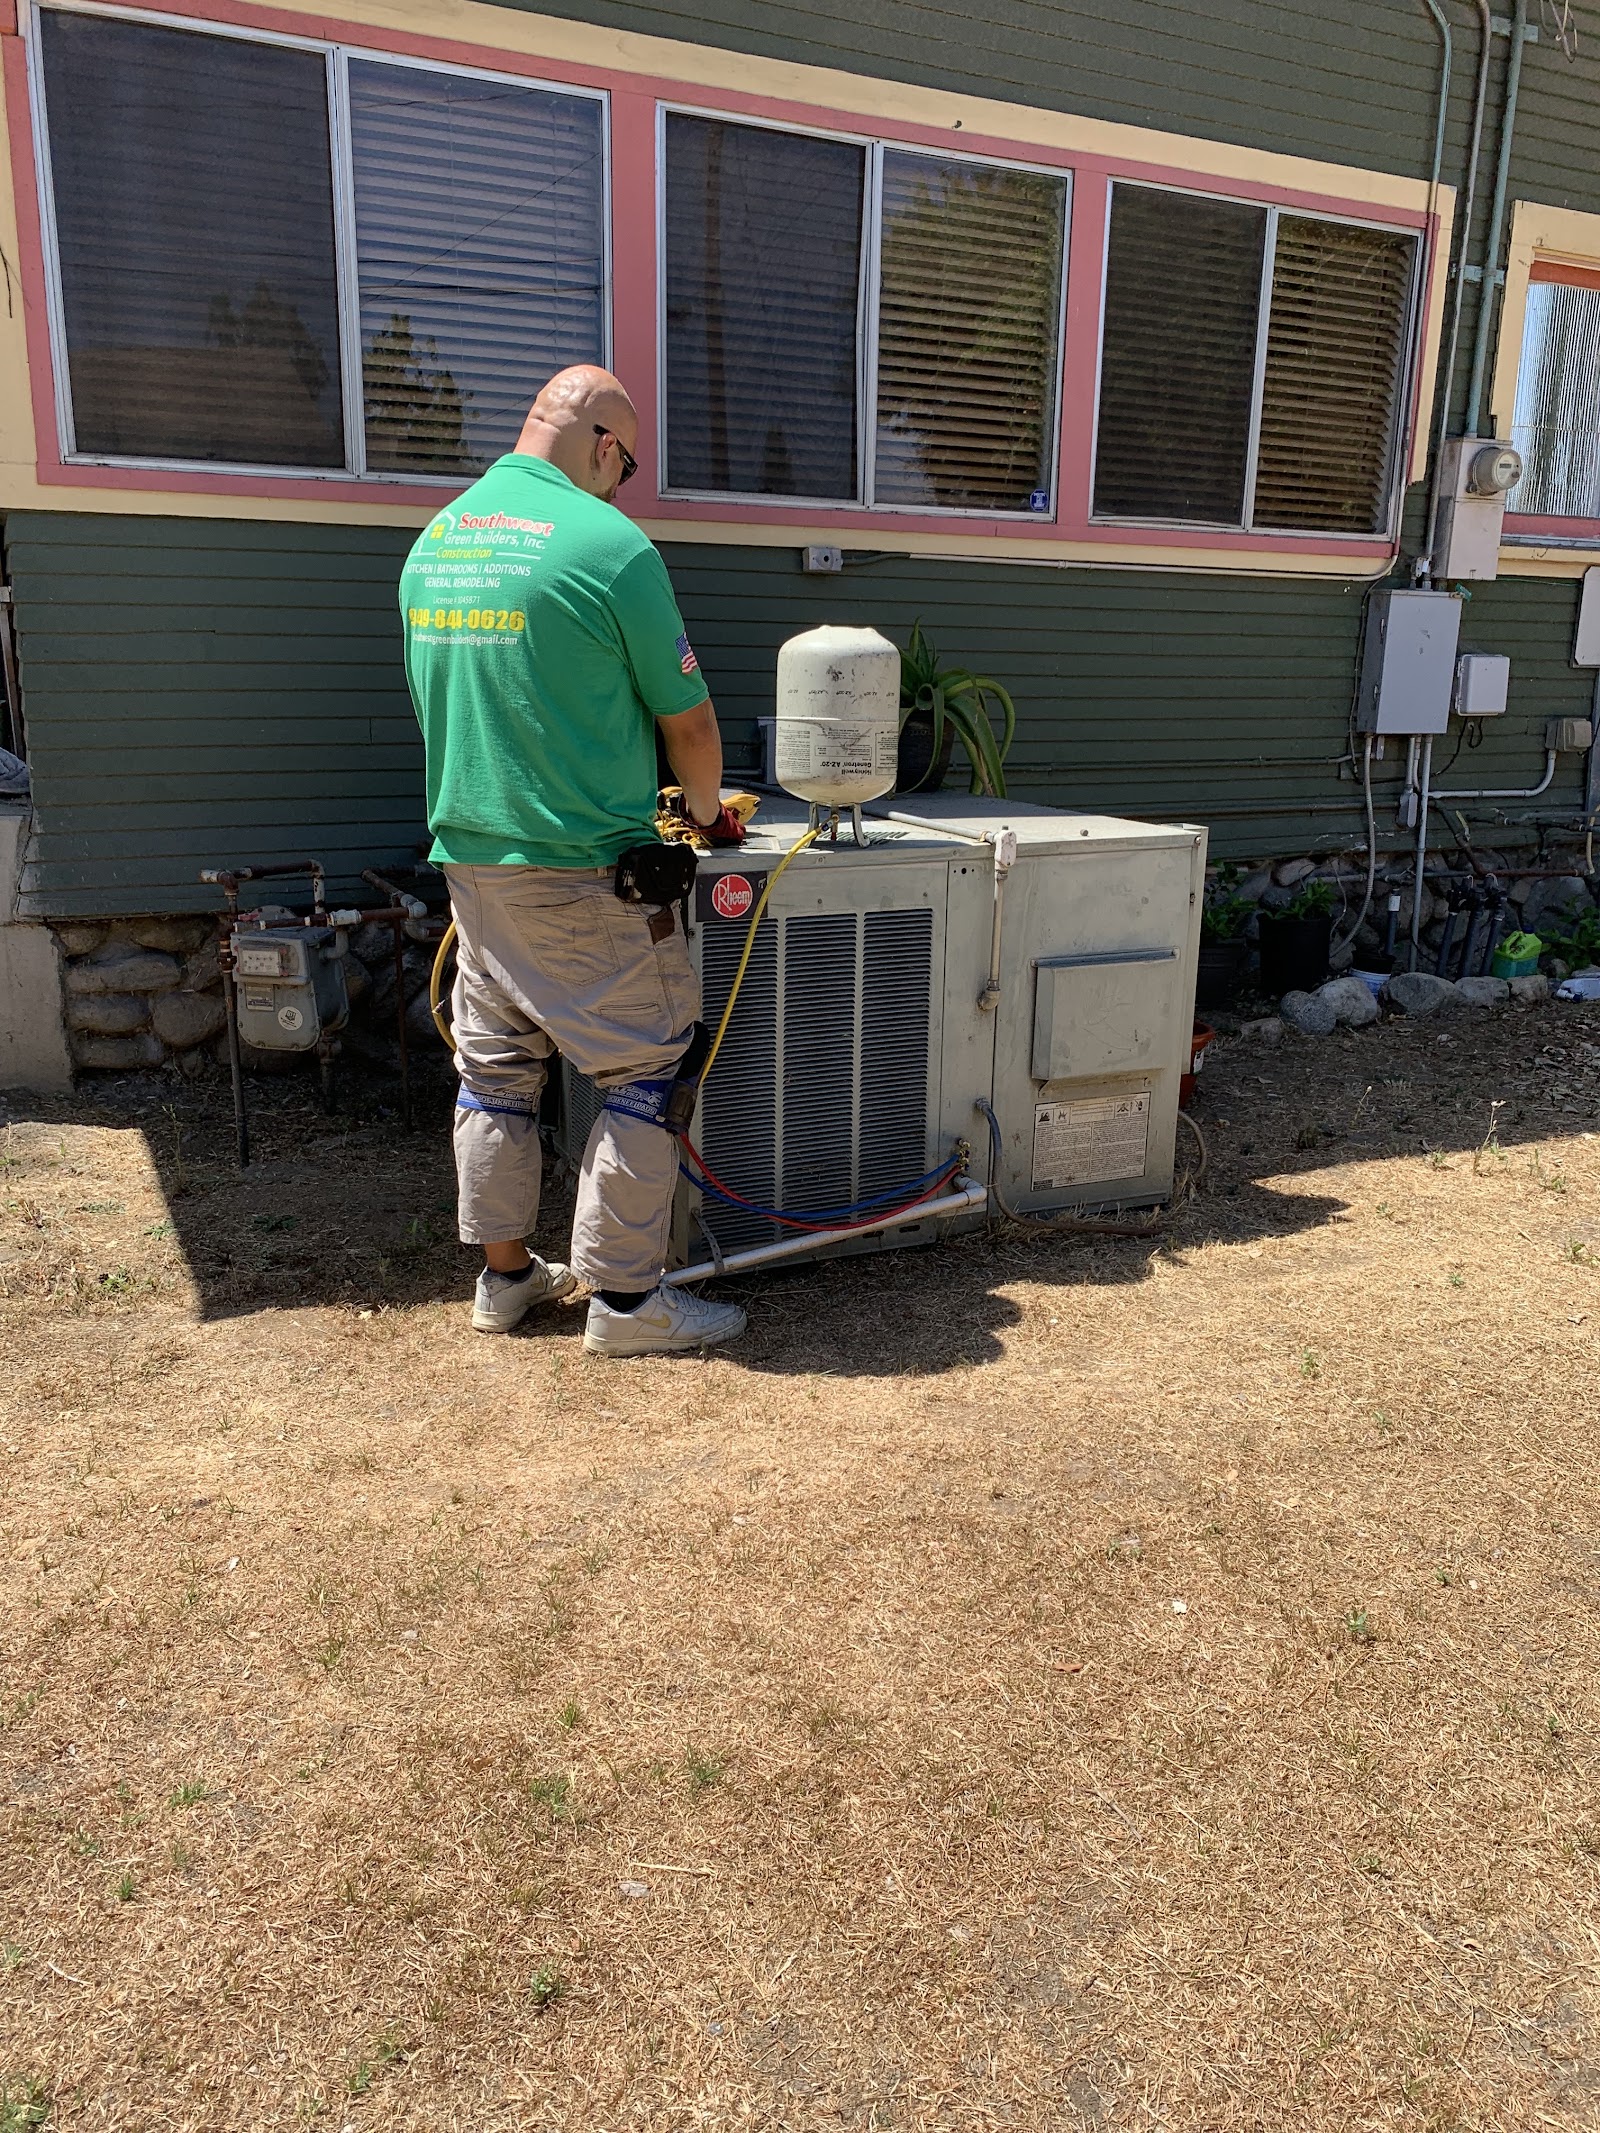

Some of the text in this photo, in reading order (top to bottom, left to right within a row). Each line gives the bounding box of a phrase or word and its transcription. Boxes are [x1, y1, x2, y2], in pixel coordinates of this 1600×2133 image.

[458, 512, 555, 536] Southwest
[444, 531, 546, 550] Green Builders, Inc.
[436, 547, 492, 559] Construction
[407, 564, 433, 574] KITCHEN
[437, 564, 478, 574] BATHROOMS
[483, 564, 532, 577] ADDITIONS
[424, 577, 500, 588] GENERAL REMODELING
[433, 595, 453, 605] License
[717, 876, 751, 911] Rheem
